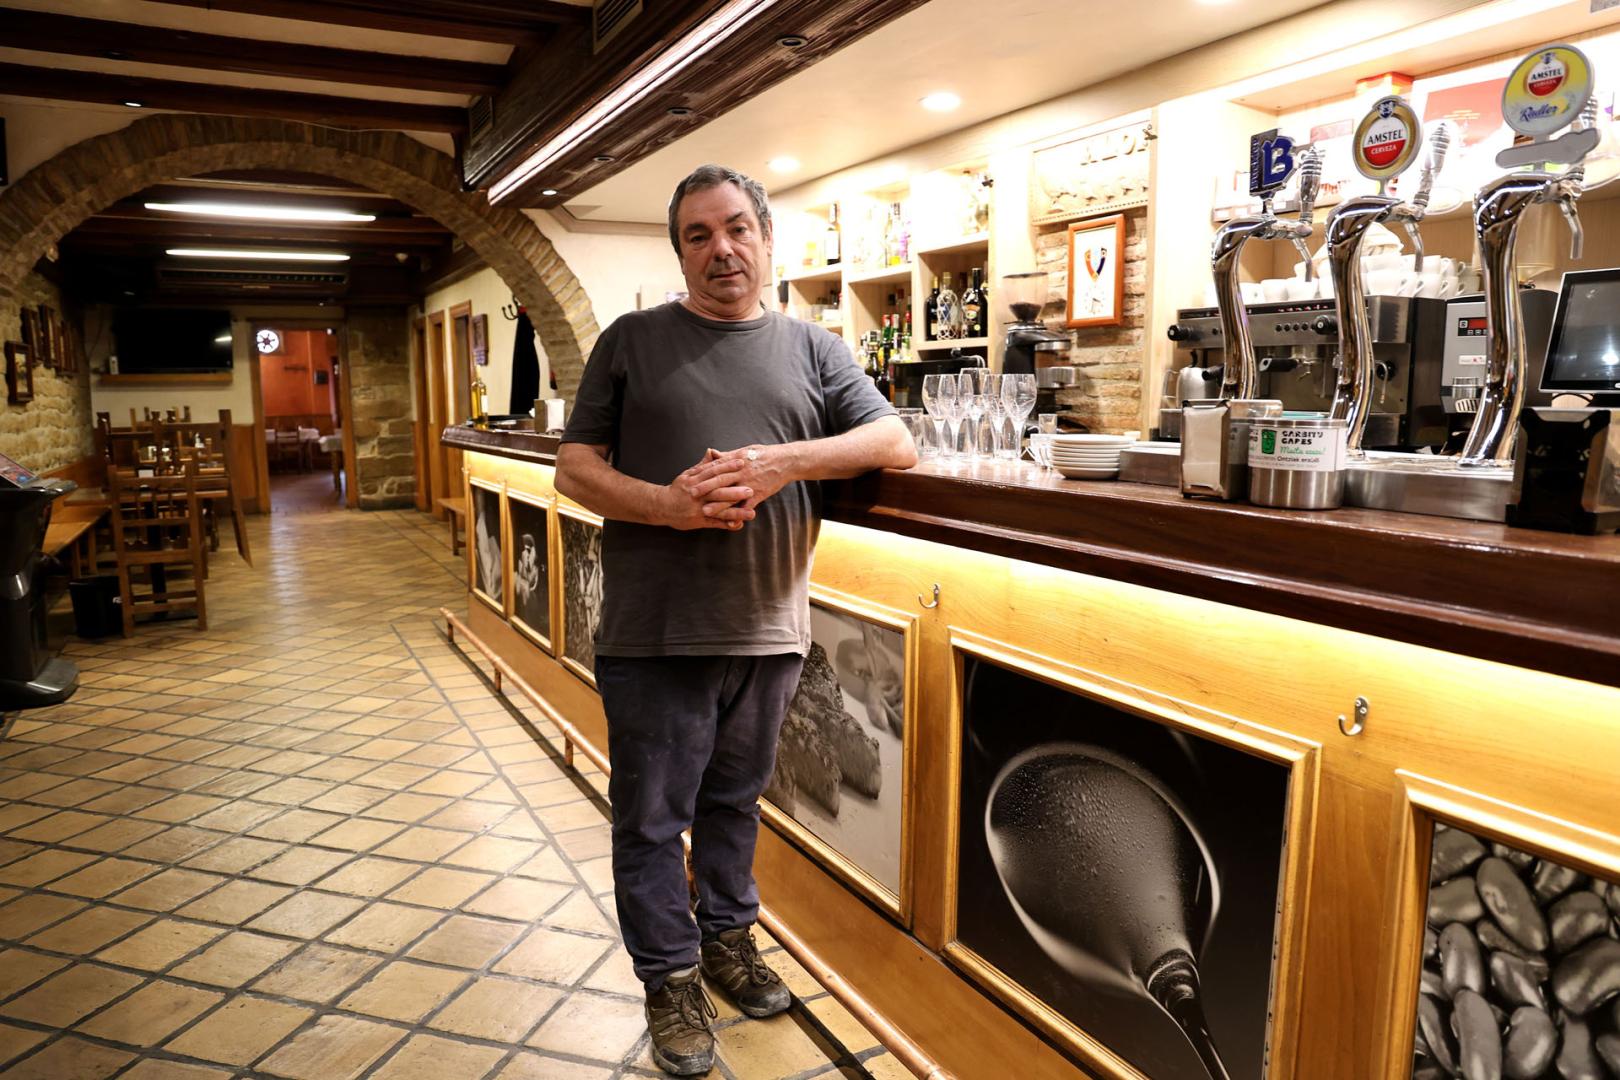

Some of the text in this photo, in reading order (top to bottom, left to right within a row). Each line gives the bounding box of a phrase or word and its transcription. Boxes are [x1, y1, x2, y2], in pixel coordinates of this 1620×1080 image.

[1531, 68, 1562, 80] AMSTEL
[1519, 103, 1558, 122] Radler
[1368, 129, 1403, 144] AMSTEL
[1371, 144, 1397, 155] CERVEZA
